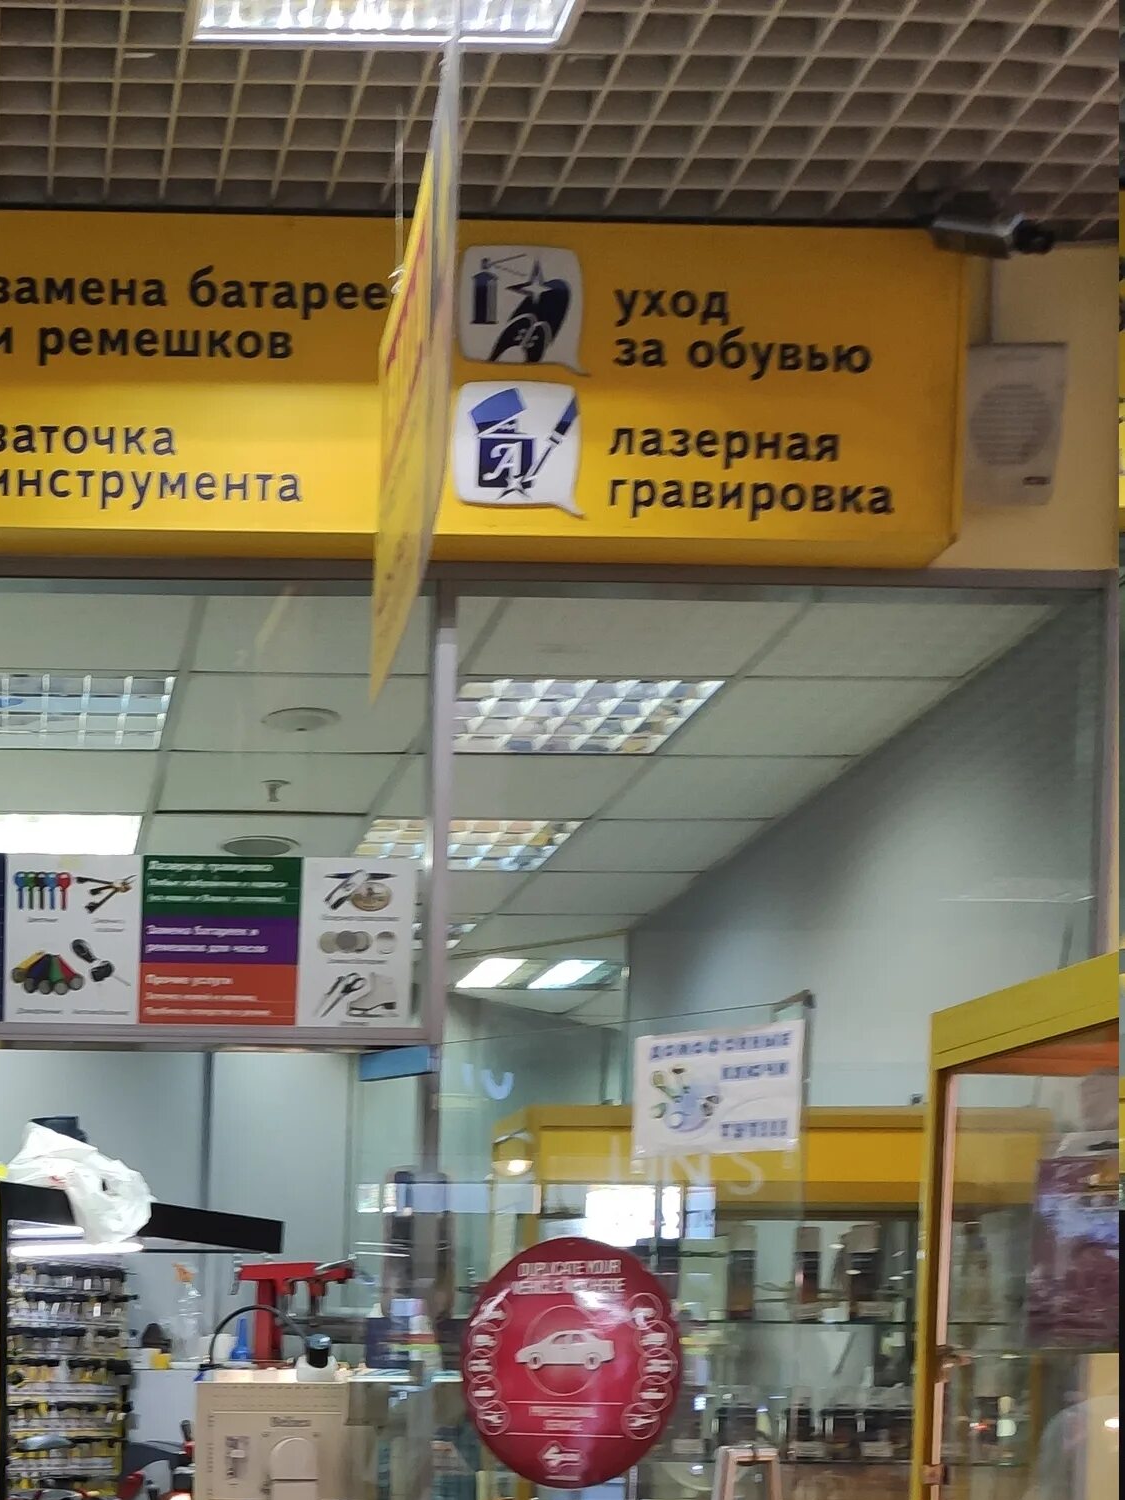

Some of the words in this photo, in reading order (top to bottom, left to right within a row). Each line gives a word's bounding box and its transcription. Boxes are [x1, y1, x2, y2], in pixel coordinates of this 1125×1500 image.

[188, 265, 388, 319] батарее
[615, 287, 729, 326] уход
[37, 324, 293, 366] ремешков
[613, 336, 667, 367] за
[687, 327, 873, 380] обувью
[608, 425, 840, 463] лазерная
[608, 476, 895, 521] гравировка
